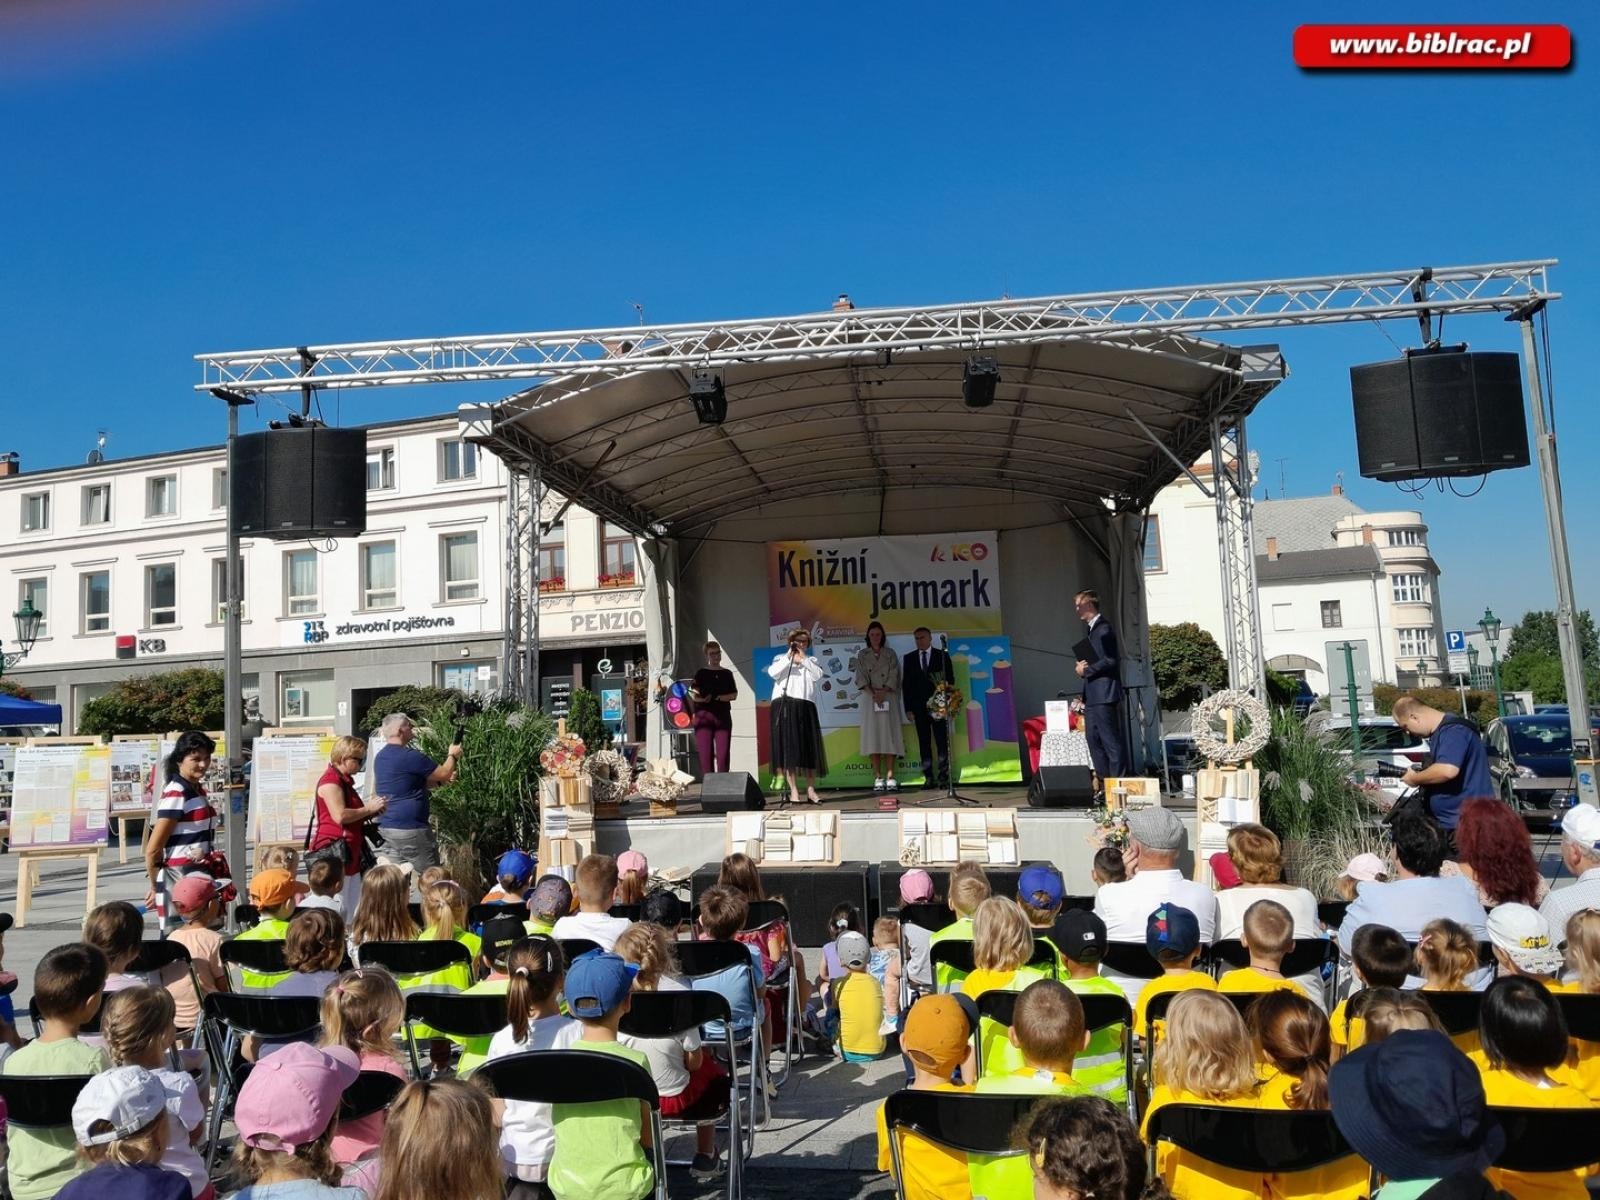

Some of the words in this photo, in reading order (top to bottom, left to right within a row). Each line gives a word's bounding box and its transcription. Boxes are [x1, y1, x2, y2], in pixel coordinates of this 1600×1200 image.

[778, 548, 869, 588] Knižní
[870, 569, 991, 619] jarmark
[336, 619, 391, 636] zdravotní
[392, 615, 456, 633] pojišťovna
[571, 610, 644, 633] PENZIO
[138, 638, 167, 653] KB
[1449, 632, 1460, 649] P
